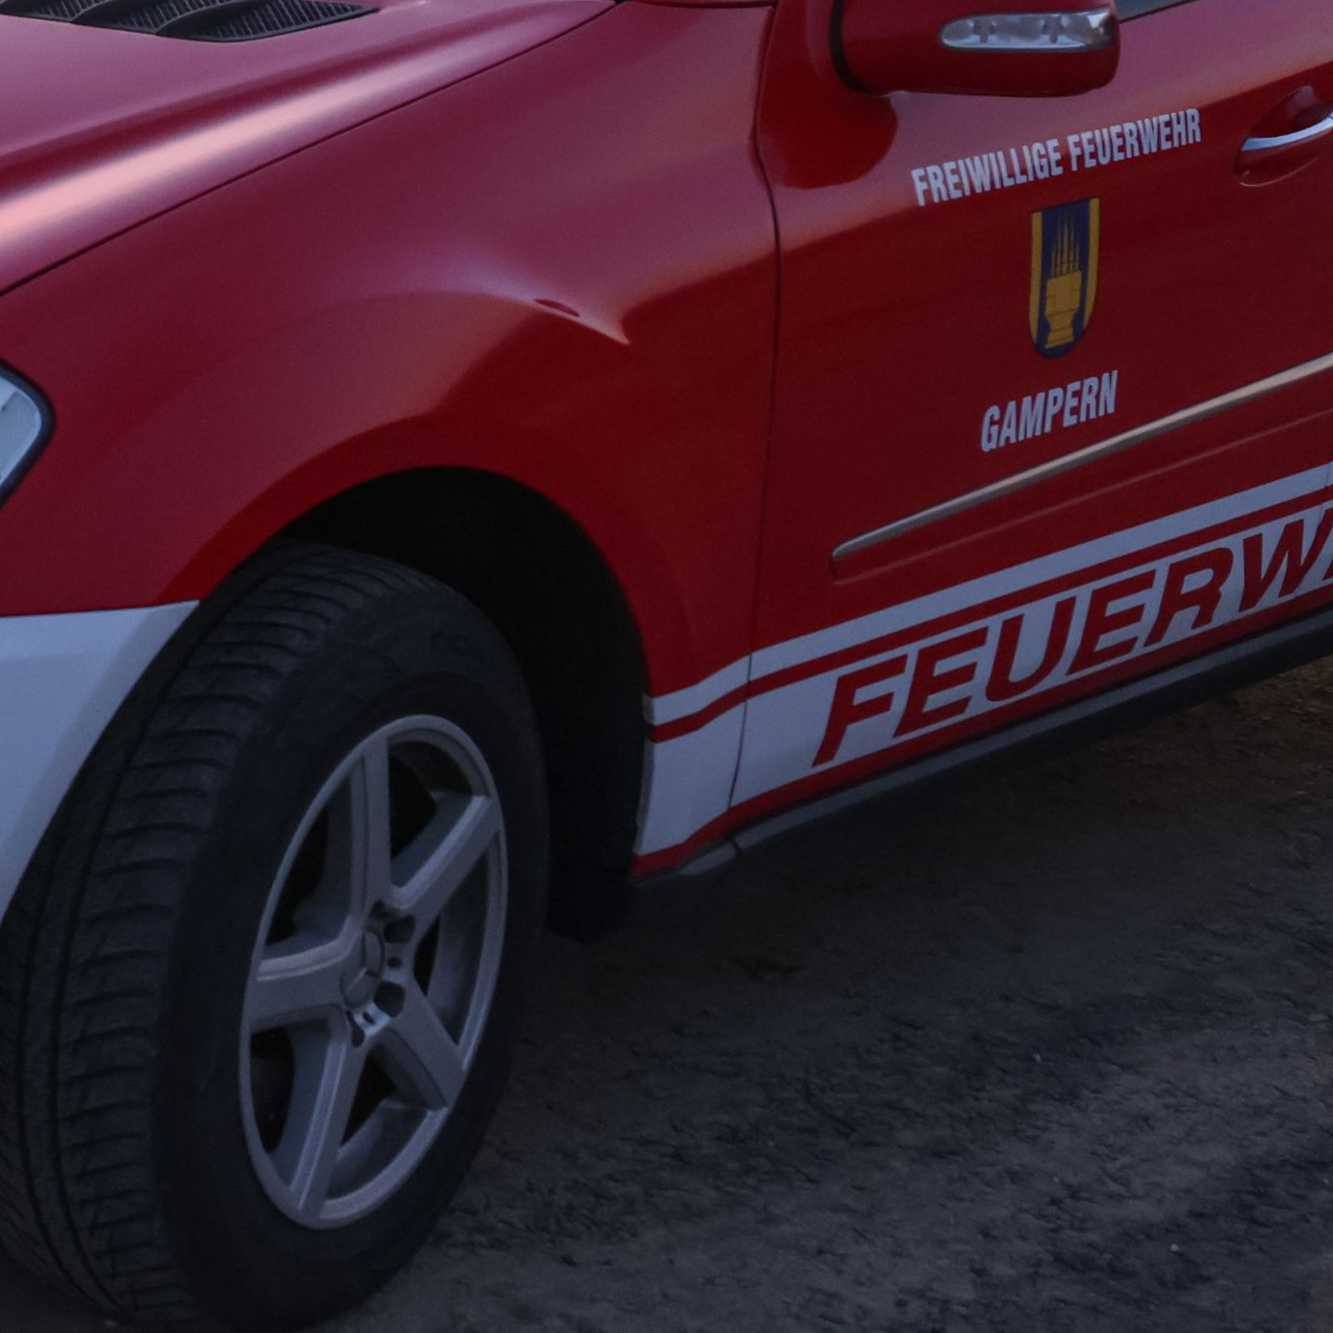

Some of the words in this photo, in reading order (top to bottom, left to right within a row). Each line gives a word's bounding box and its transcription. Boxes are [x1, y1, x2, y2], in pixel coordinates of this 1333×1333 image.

[911, 138, 1064, 207] FREIWILLIGE
[1067, 107, 1201, 172] FEUERWEHR
[980, 370, 1119, 453] GAMPERN
[812, 507, 1333, 768] FEUERW
